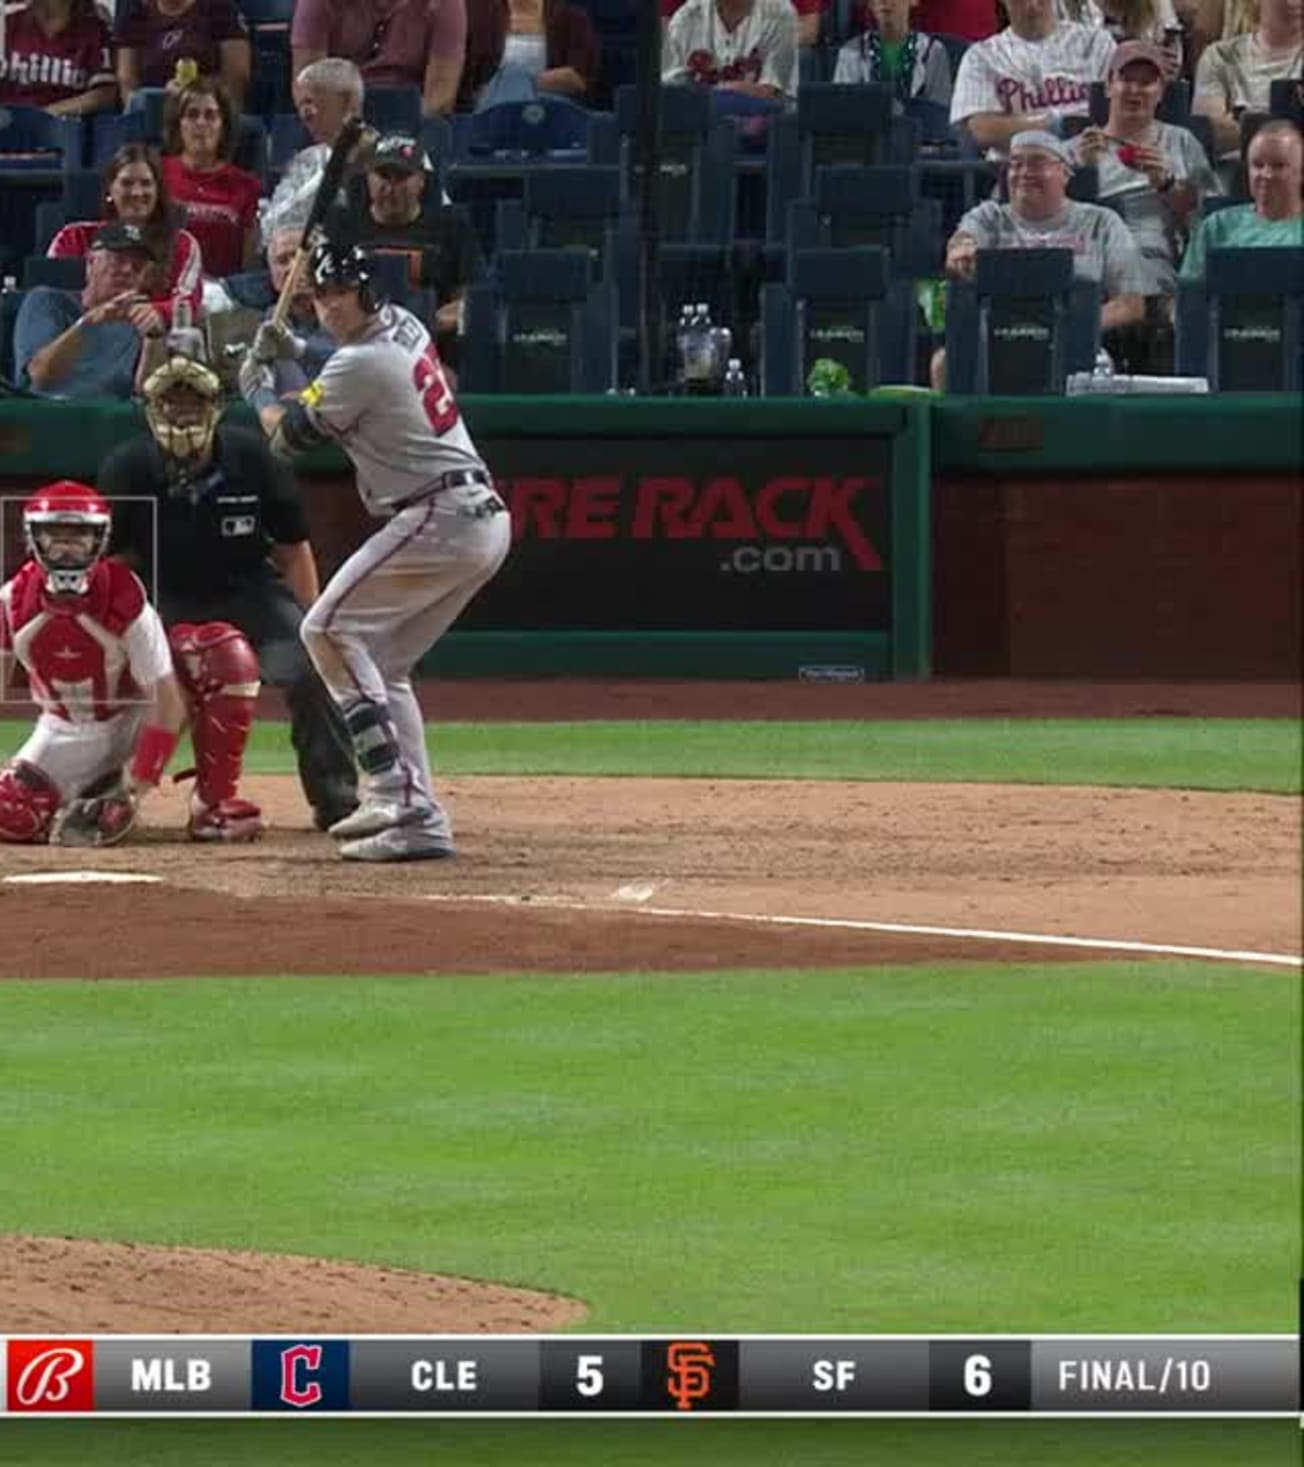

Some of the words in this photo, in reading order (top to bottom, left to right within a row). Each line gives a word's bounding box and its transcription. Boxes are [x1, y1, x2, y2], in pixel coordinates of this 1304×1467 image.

[497, 474, 622, 540] RE
[631, 474, 884, 571] RACK
[719, 546, 841, 573] .com
